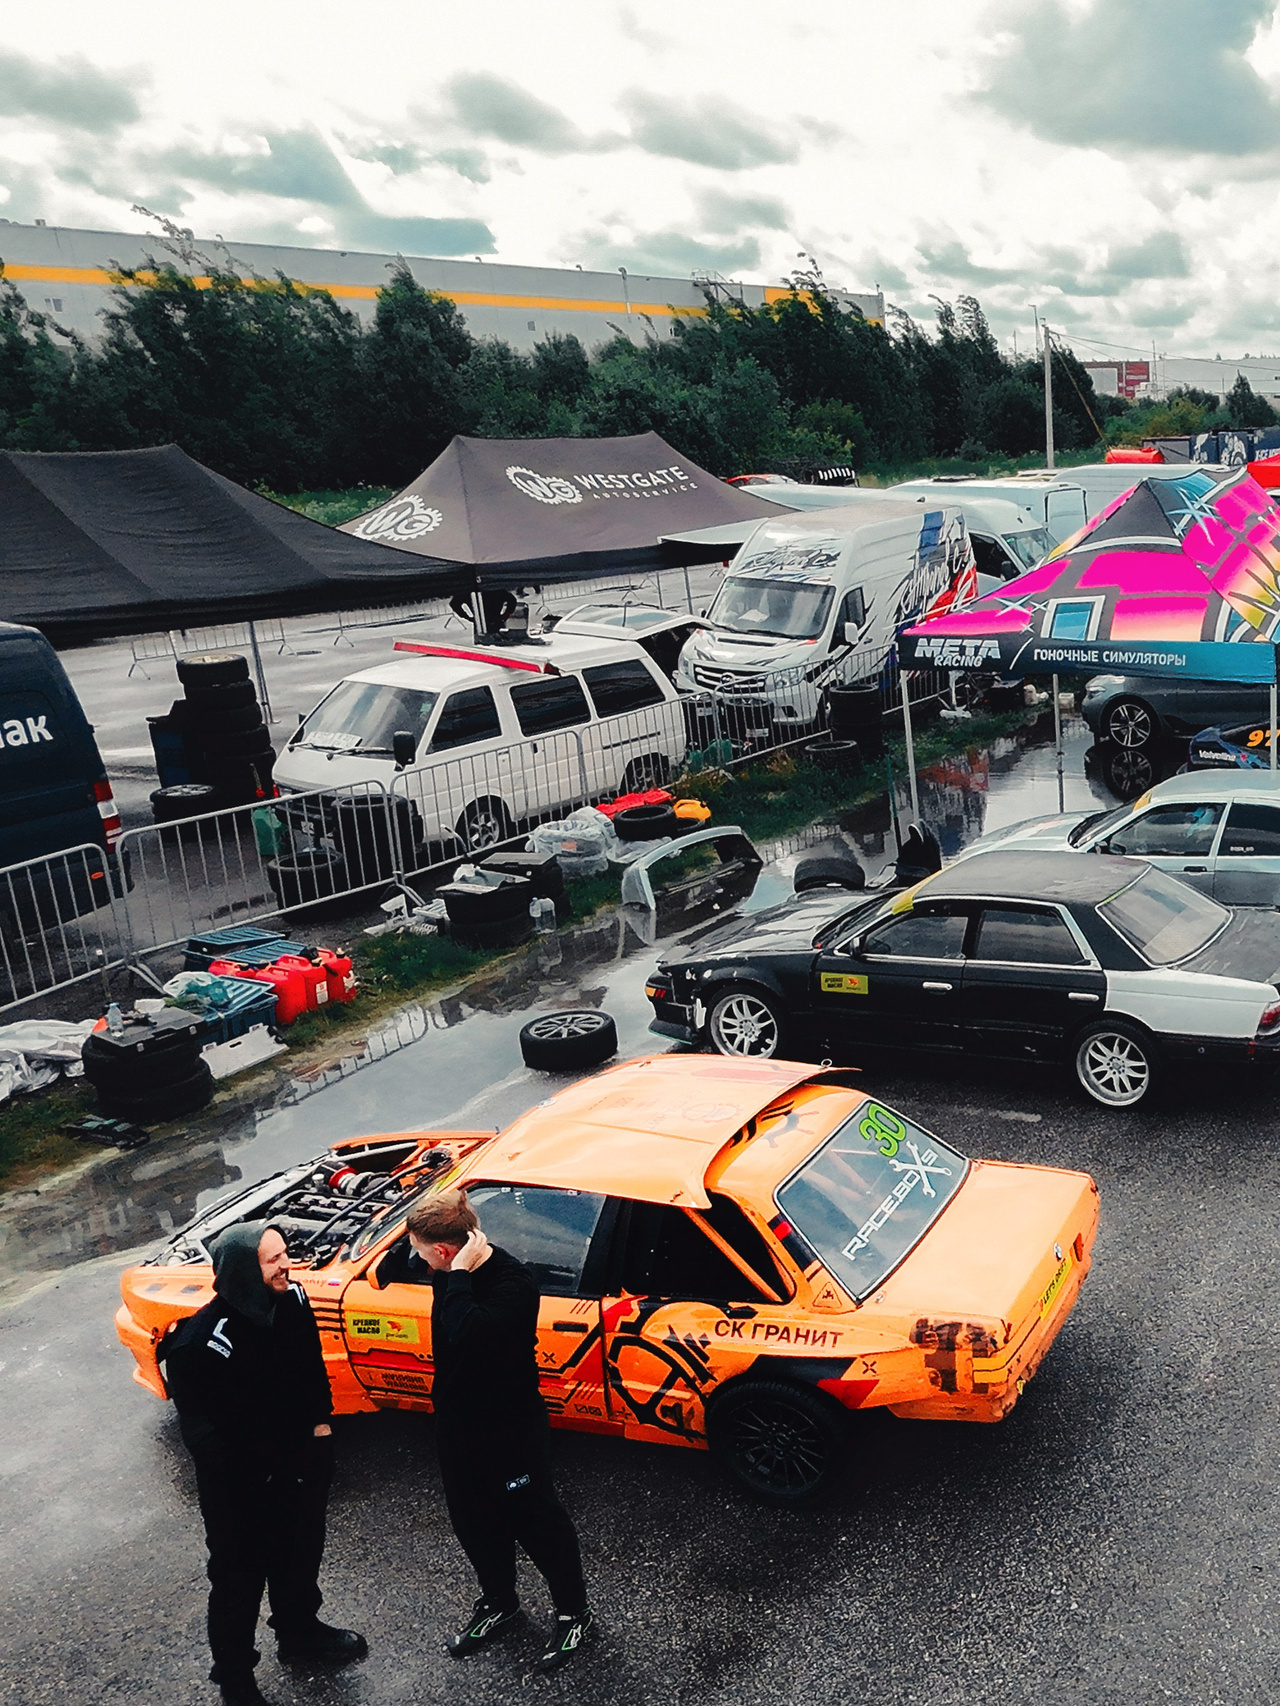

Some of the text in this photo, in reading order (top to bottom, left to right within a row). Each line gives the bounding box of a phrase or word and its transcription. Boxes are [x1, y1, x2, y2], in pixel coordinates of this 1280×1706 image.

[574, 465, 689, 491] WESTGATE
[592, 482, 699, 500] AUTOSERVICE
[914, 638, 1001, 658] META
[1033, 648, 1186, 666] ГОНОЧНЫЕ СИМУЛЯТОРЫ
[934, 655, 983, 668] RACING
[0, 715, 54, 749] ак
[859, 1103, 907, 1157] 30
[714, 1319, 844, 1349] СК ГРАНИТ
